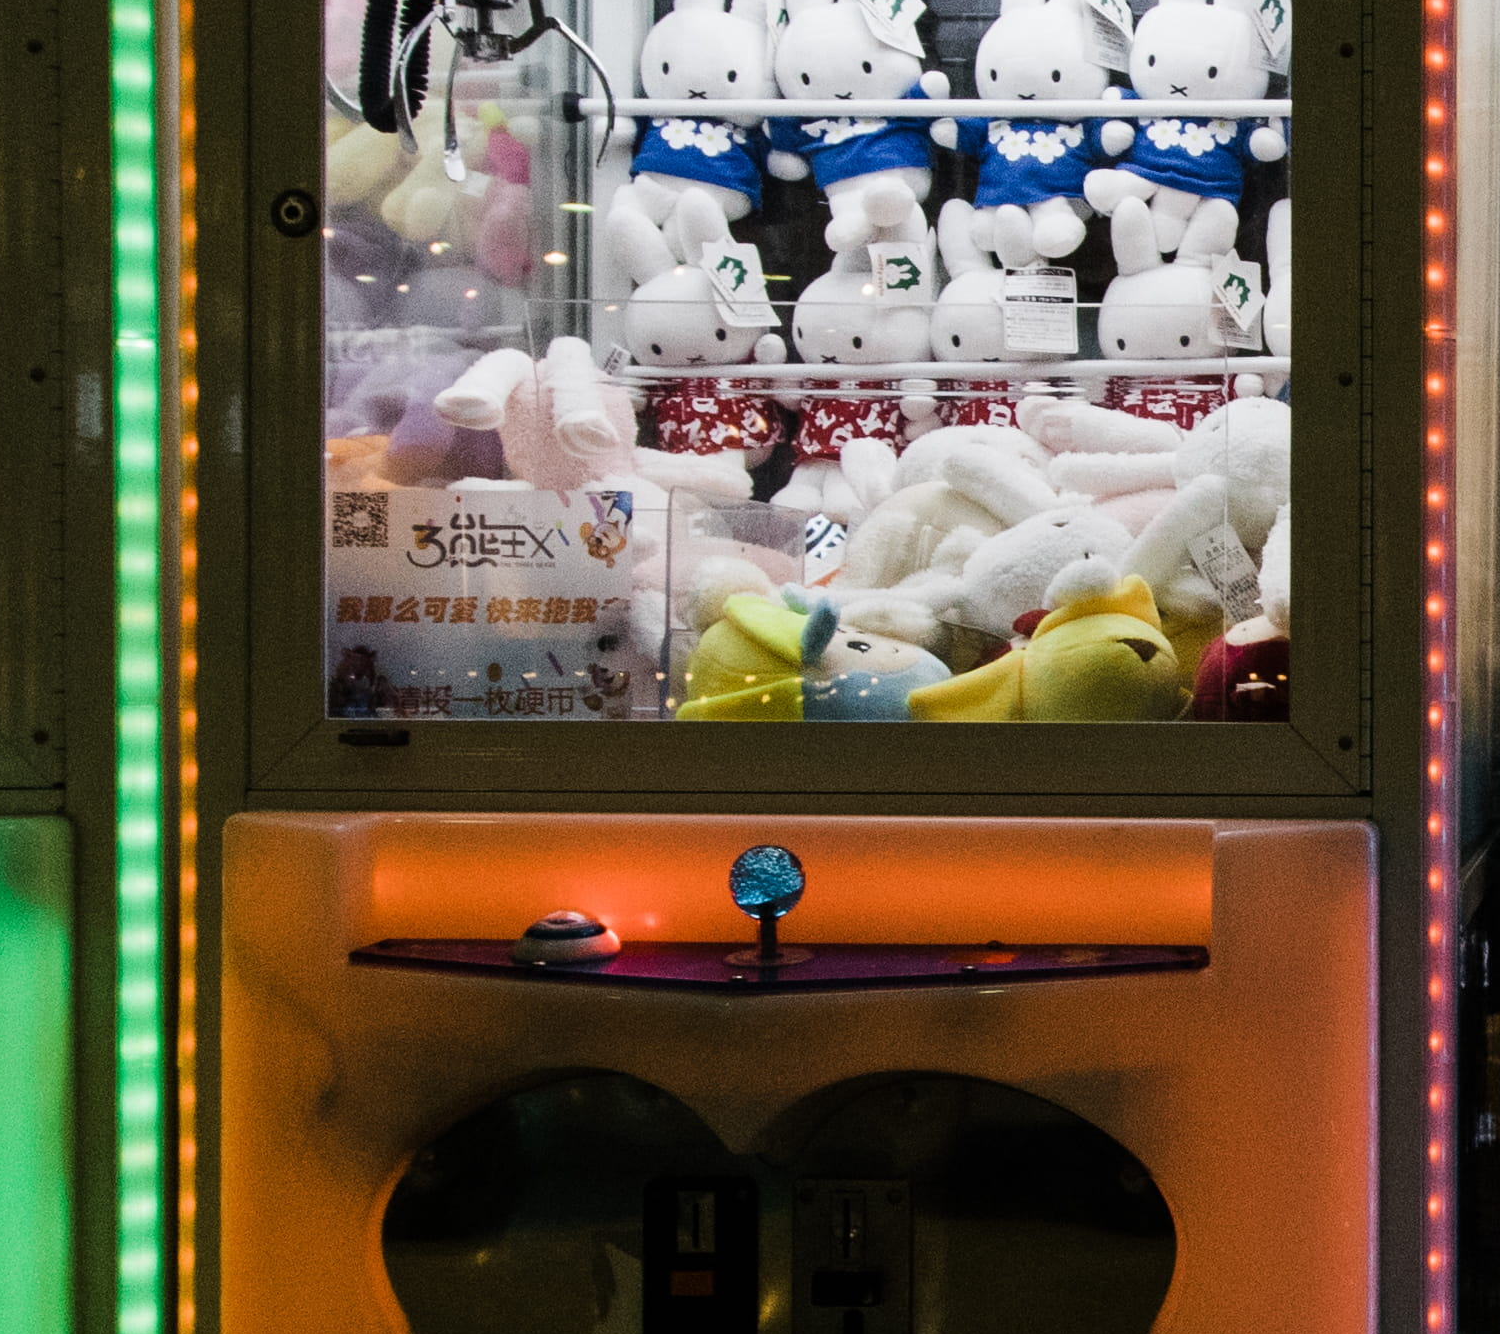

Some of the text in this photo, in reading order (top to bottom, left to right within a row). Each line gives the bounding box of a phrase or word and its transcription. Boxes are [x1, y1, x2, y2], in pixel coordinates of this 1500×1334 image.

[336, 596, 478, 624] 我那么可爱
[393, 684, 575, 716] 请投一枚硬币
